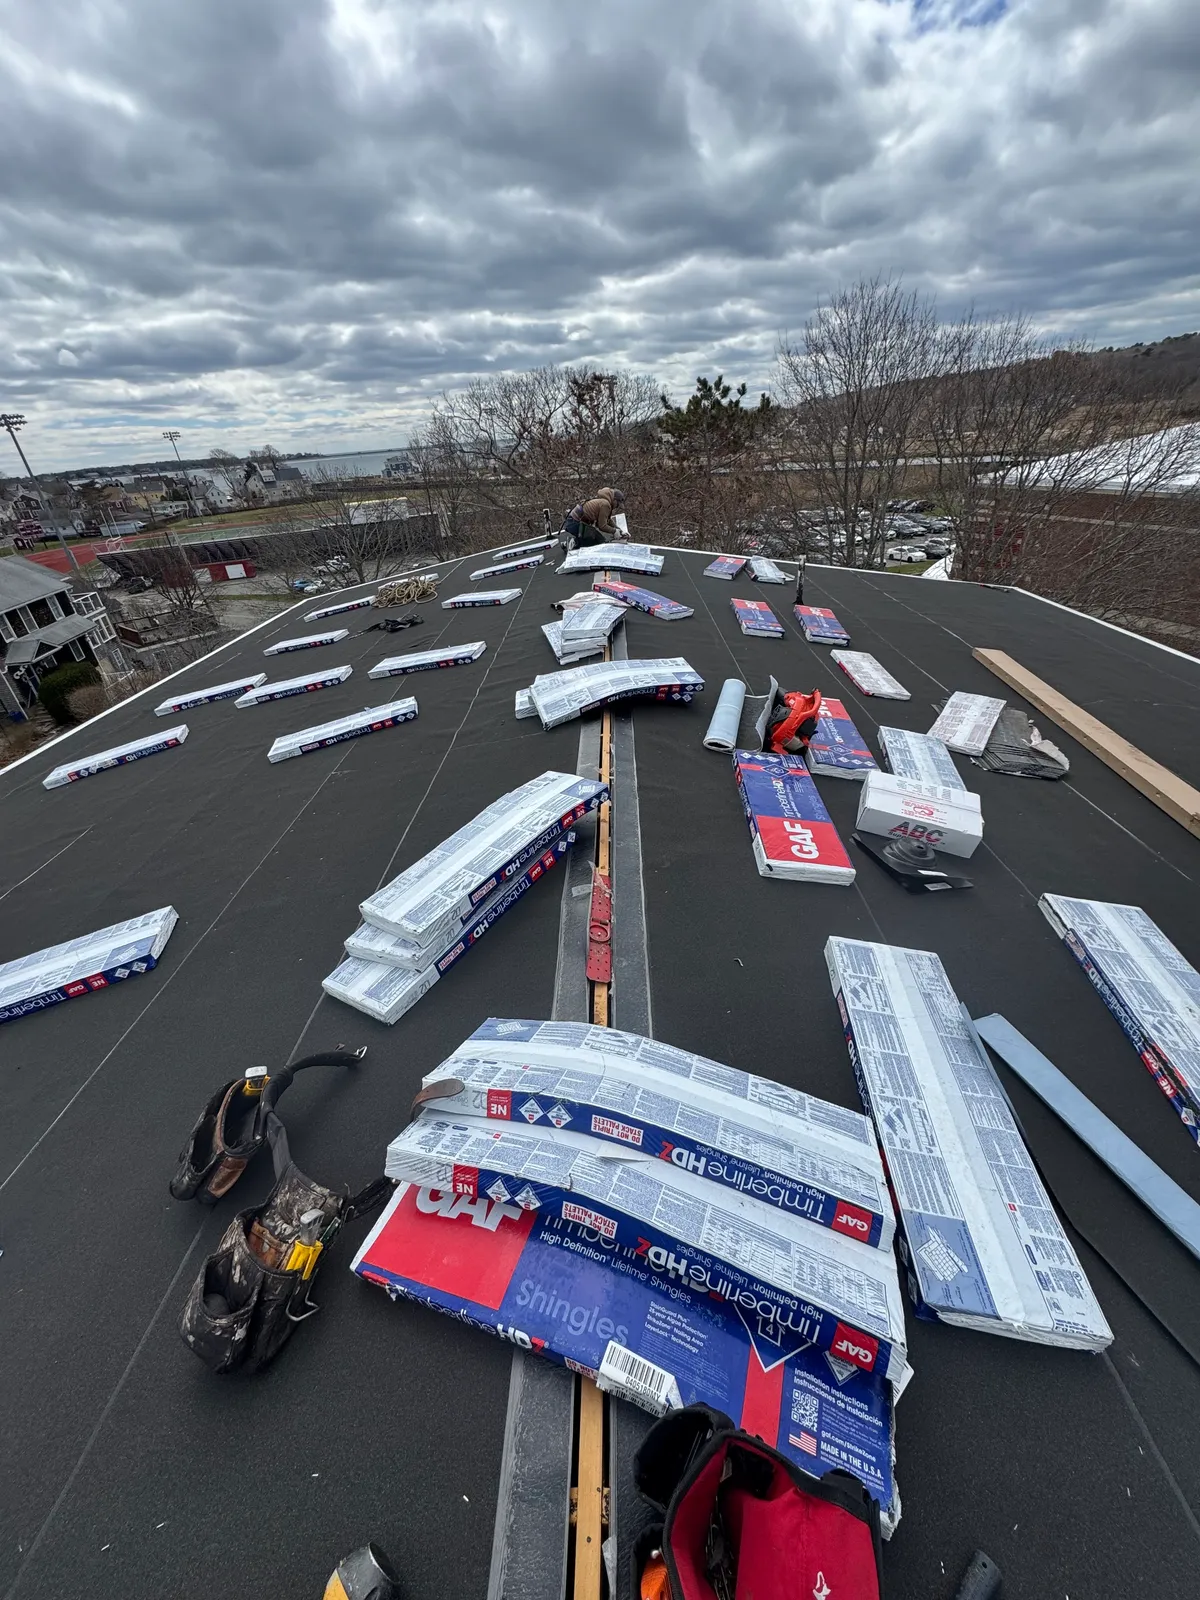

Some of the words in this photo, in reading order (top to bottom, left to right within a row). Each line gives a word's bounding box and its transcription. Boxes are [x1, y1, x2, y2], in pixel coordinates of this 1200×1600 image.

[783, 821, 819, 859] GAF
[889, 821, 948, 843] ABC
[545, 856, 554, 866] NE
[487, 877, 532, 922] Timberline
[69, 985, 84, 993] GAF
[93, 979, 105, 987] NE
[0, 992, 66, 1019] Timberline
[1159, 1077, 1174, 1095] NE
[491, 1104, 507, 1116] NE
[593, 1123, 614, 1135] TRIPLE
[594, 1116, 620, 1130] PALLETS
[622, 1126, 642, 1137] STACK
[617, 1131, 629, 1140] NOT
[632, 1135, 640, 1144] DO
[658, 1141, 707, 1176] HDZ
[696, 1144, 728, 1164] Shingles
[456, 1183, 473, 1195] NE
[708, 1161, 824, 1223] Timberline
[806, 1187, 826, 1201] High
[563, 1211, 586, 1224] TRIPLE
[564, 1203, 592, 1218] PALLETS
[589, 1221, 601, 1232] NOT
[593, 1215, 616, 1230] STACK
[837, 1213, 868, 1232] GAF
[604, 1228, 614, 1237] DO
[635, 1236, 687, 1276] HDZ
[676, 1244, 712, 1268] Shingles
[540, 1230, 562, 1246] High
[563, 1237, 607, 1263] Definition
[650, 1276, 692, 1303] Shingles
[515, 1278, 629, 1347] Shingles
[689, 1264, 821, 1344] Timberline
[801, 1305, 823, 1322] High
[670, 1334, 699, 1354] Technology
[673, 1327, 691, 1342] Nailing
[691, 1337, 704, 1347] Area
[835, 1341, 873, 1364] GAF
[795, 1368, 830, 1392] Installation
[831, 1384, 869, 1411] instructions
[794, 1376, 835, 1403] Instrucciones
[837, 1398, 846, 1408] de
[846, 1403, 883, 1428] instalación
[821, 1441, 839, 1457] MADE
[840, 1451, 848, 1460] IN
[849, 1455, 862, 1469] THE
[864, 1460, 885, 1480] U.S.A.
